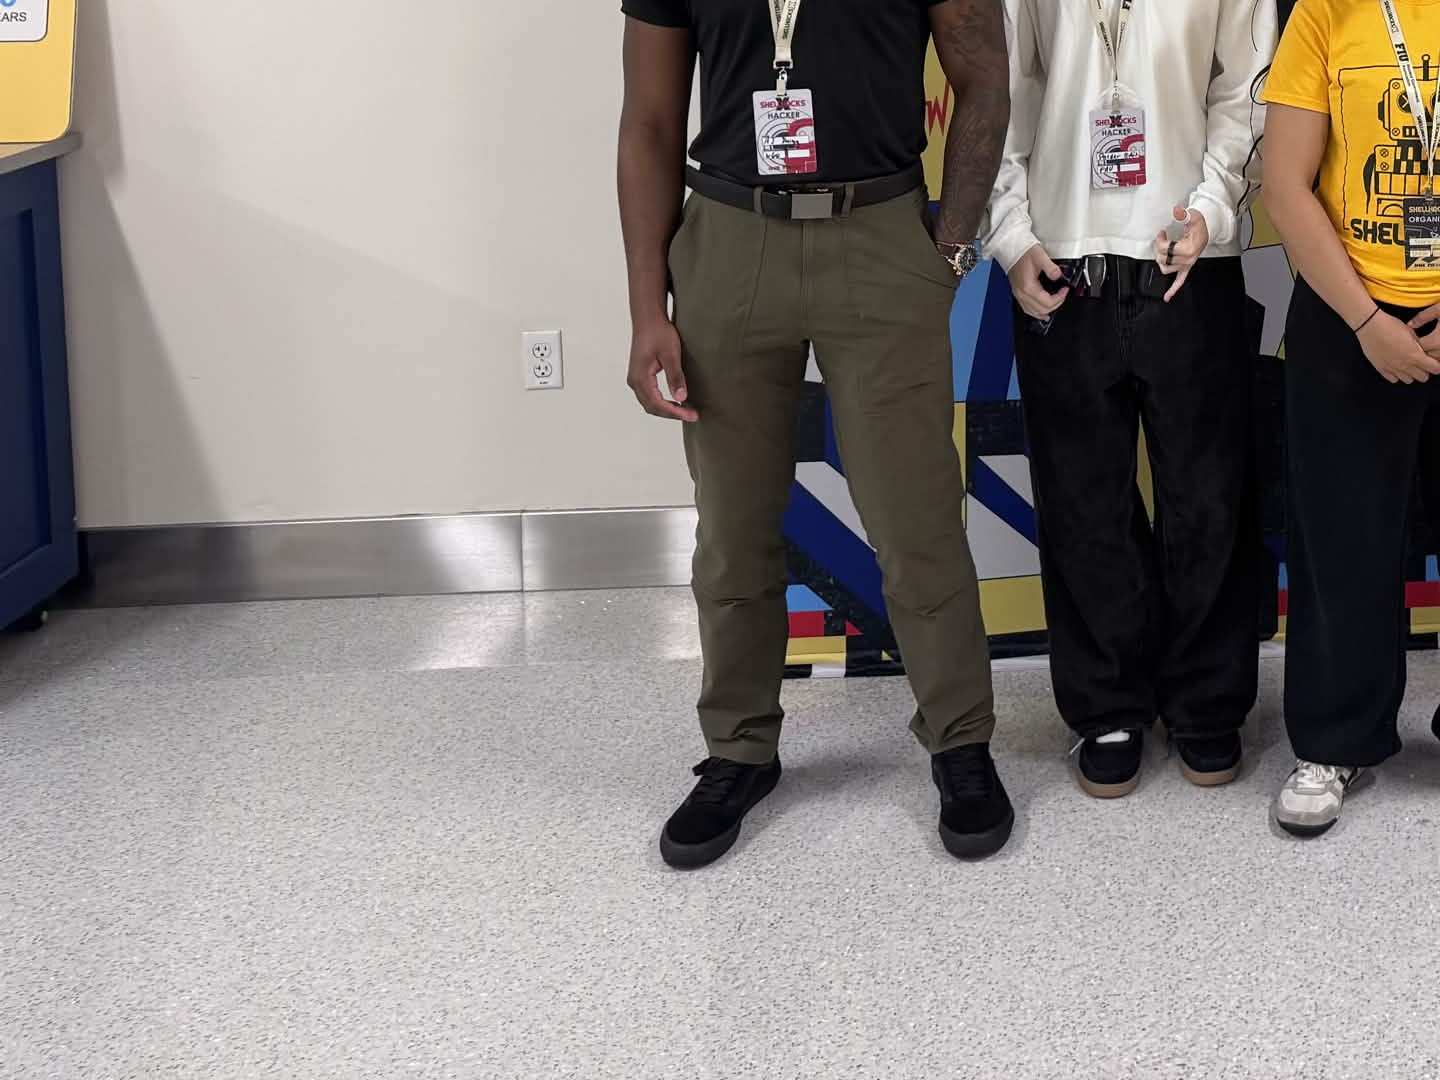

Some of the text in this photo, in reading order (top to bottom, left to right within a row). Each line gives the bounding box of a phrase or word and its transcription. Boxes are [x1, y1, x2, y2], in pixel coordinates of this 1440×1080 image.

[1394, 43, 1410, 62] FIU
[767, 111, 800, 120] HACKER
[1101, 128, 1132, 137] HACKER
